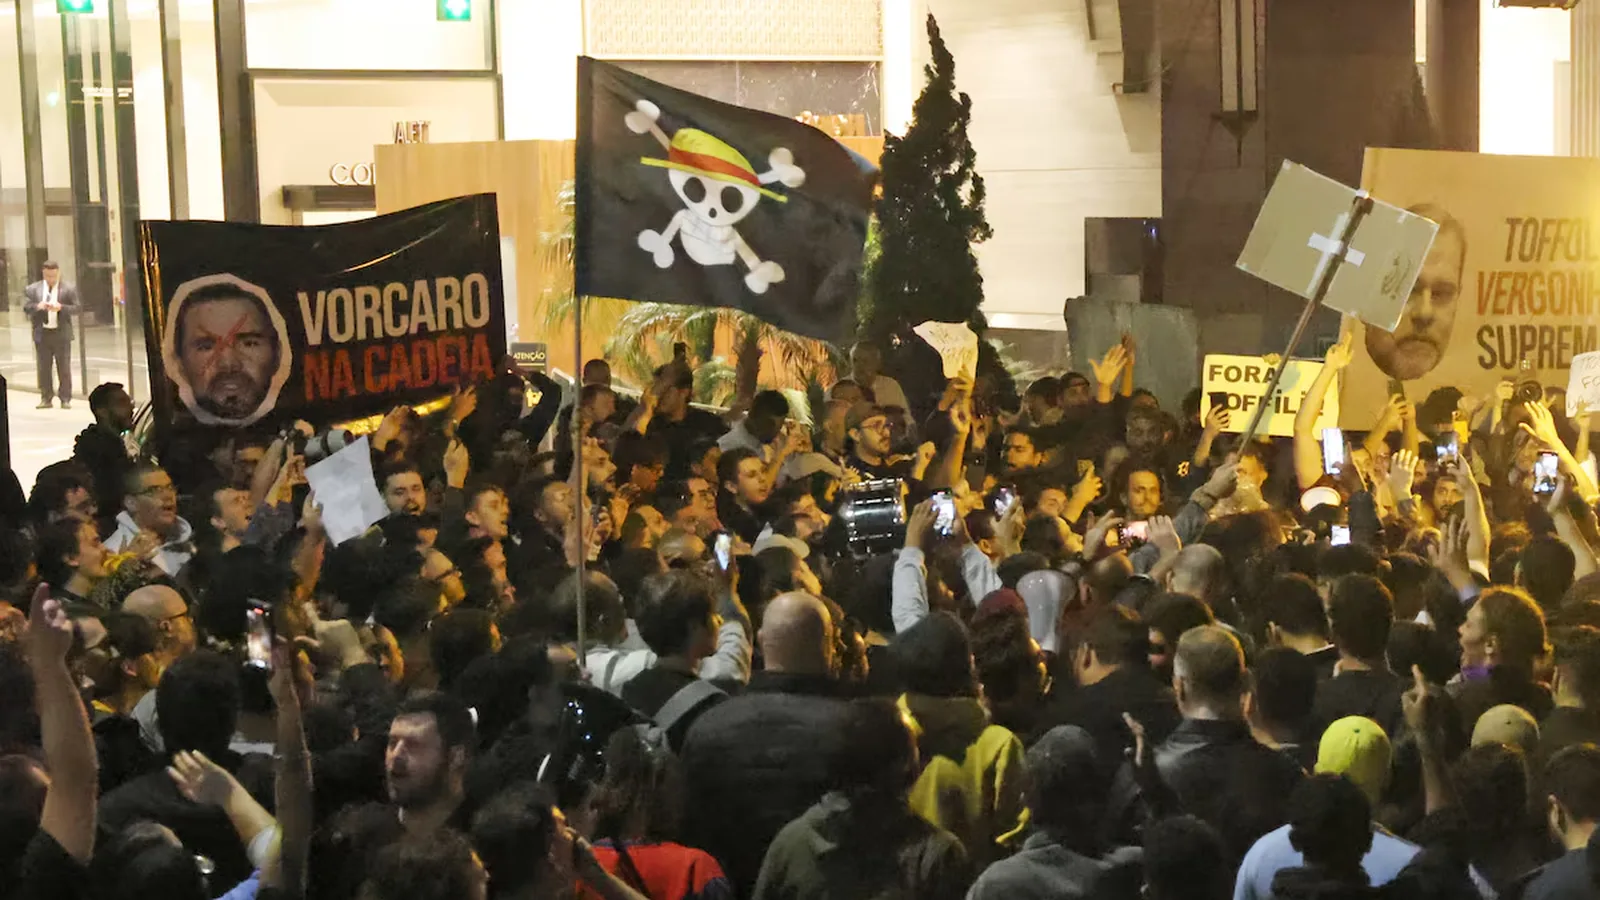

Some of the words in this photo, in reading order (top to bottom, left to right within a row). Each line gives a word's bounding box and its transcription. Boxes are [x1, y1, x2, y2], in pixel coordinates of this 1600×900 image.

[297, 272, 490, 346] VORCARO
[304, 349, 356, 400] NA
[364, 333, 495, 393] CADEIA
[513, 350, 545, 361] ATENÇÃO
[1208, 364, 1280, 384] FORA
